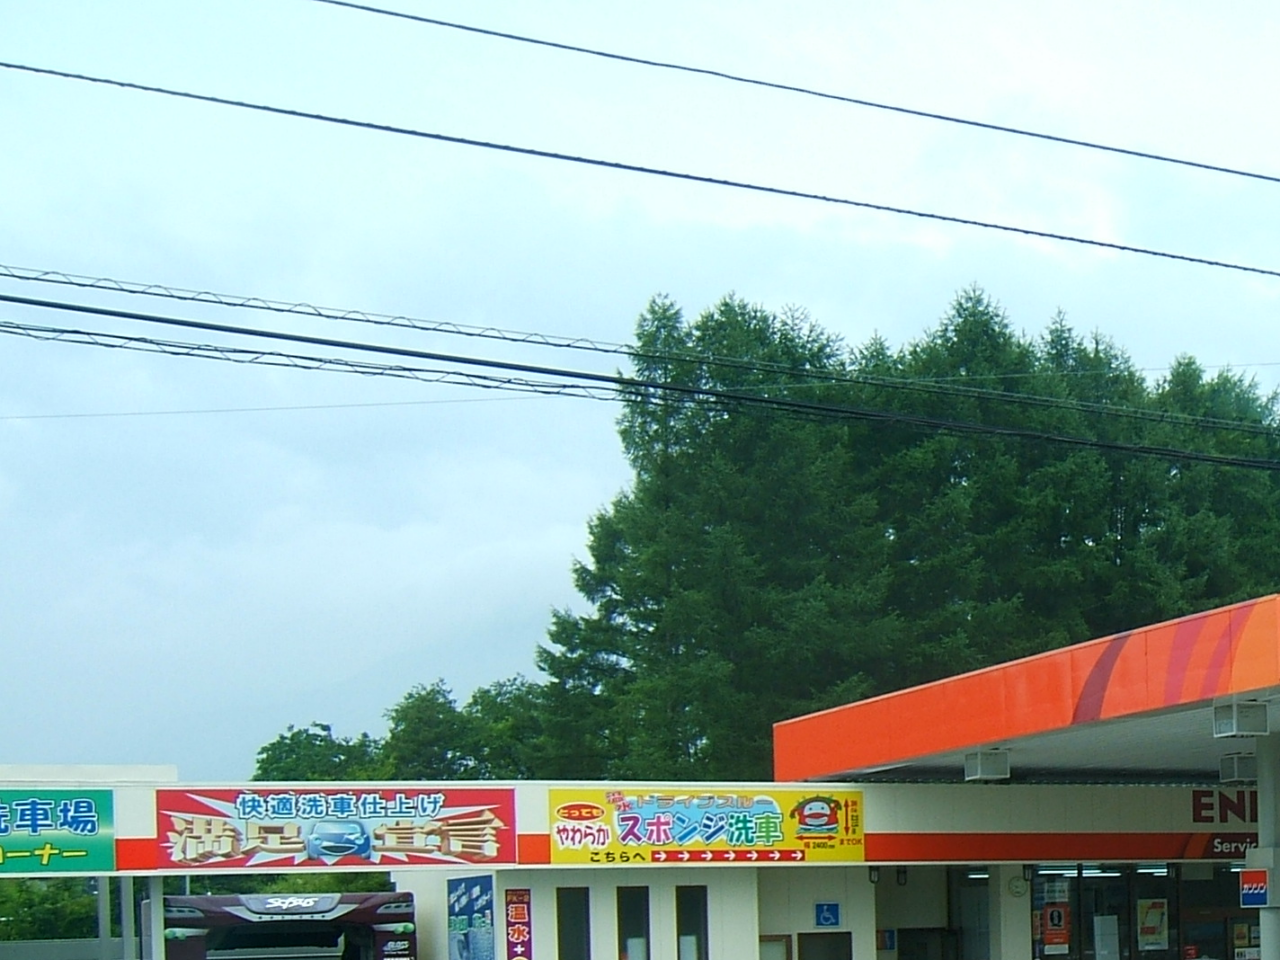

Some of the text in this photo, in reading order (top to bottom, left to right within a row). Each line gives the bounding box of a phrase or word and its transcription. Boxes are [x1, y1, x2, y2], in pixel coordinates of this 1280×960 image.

[236, 791, 445, 819] 快適洗車仕上げ
[636, 794, 775, 808] ドライブスルー
[0, 798, 98, 836] 車場
[555, 822, 611, 848] やわらか
[618, 812, 784, 847] スポンジ洗車
[0, 843, 87, 865] ーナー
[590, 851, 646, 862] こちらへ
[1213, 838, 1257, 852] Servic
